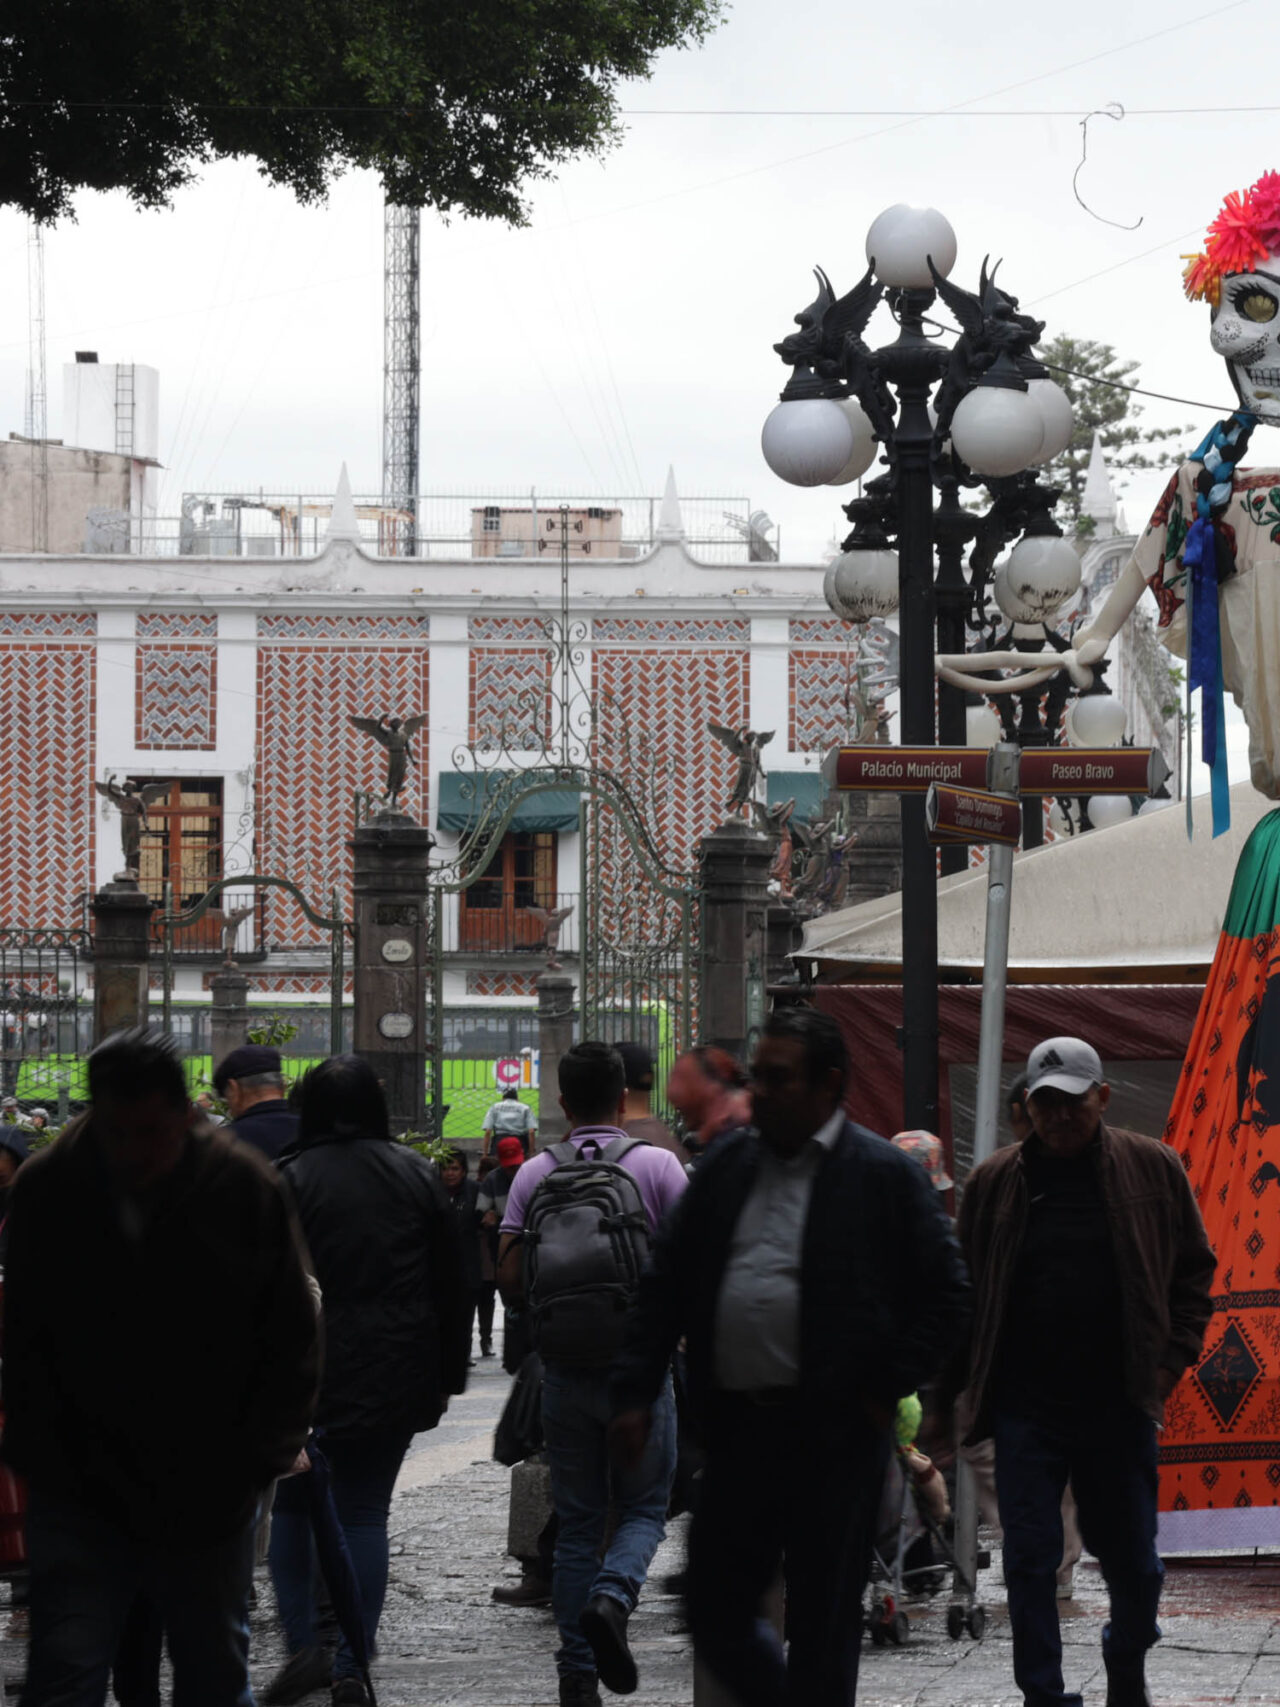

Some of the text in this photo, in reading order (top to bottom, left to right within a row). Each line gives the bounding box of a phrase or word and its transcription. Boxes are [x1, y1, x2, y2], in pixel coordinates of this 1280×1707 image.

[861, 761, 963, 779] Palacio Municipal
[1052, 763, 1114, 779] Paseo Bravo
